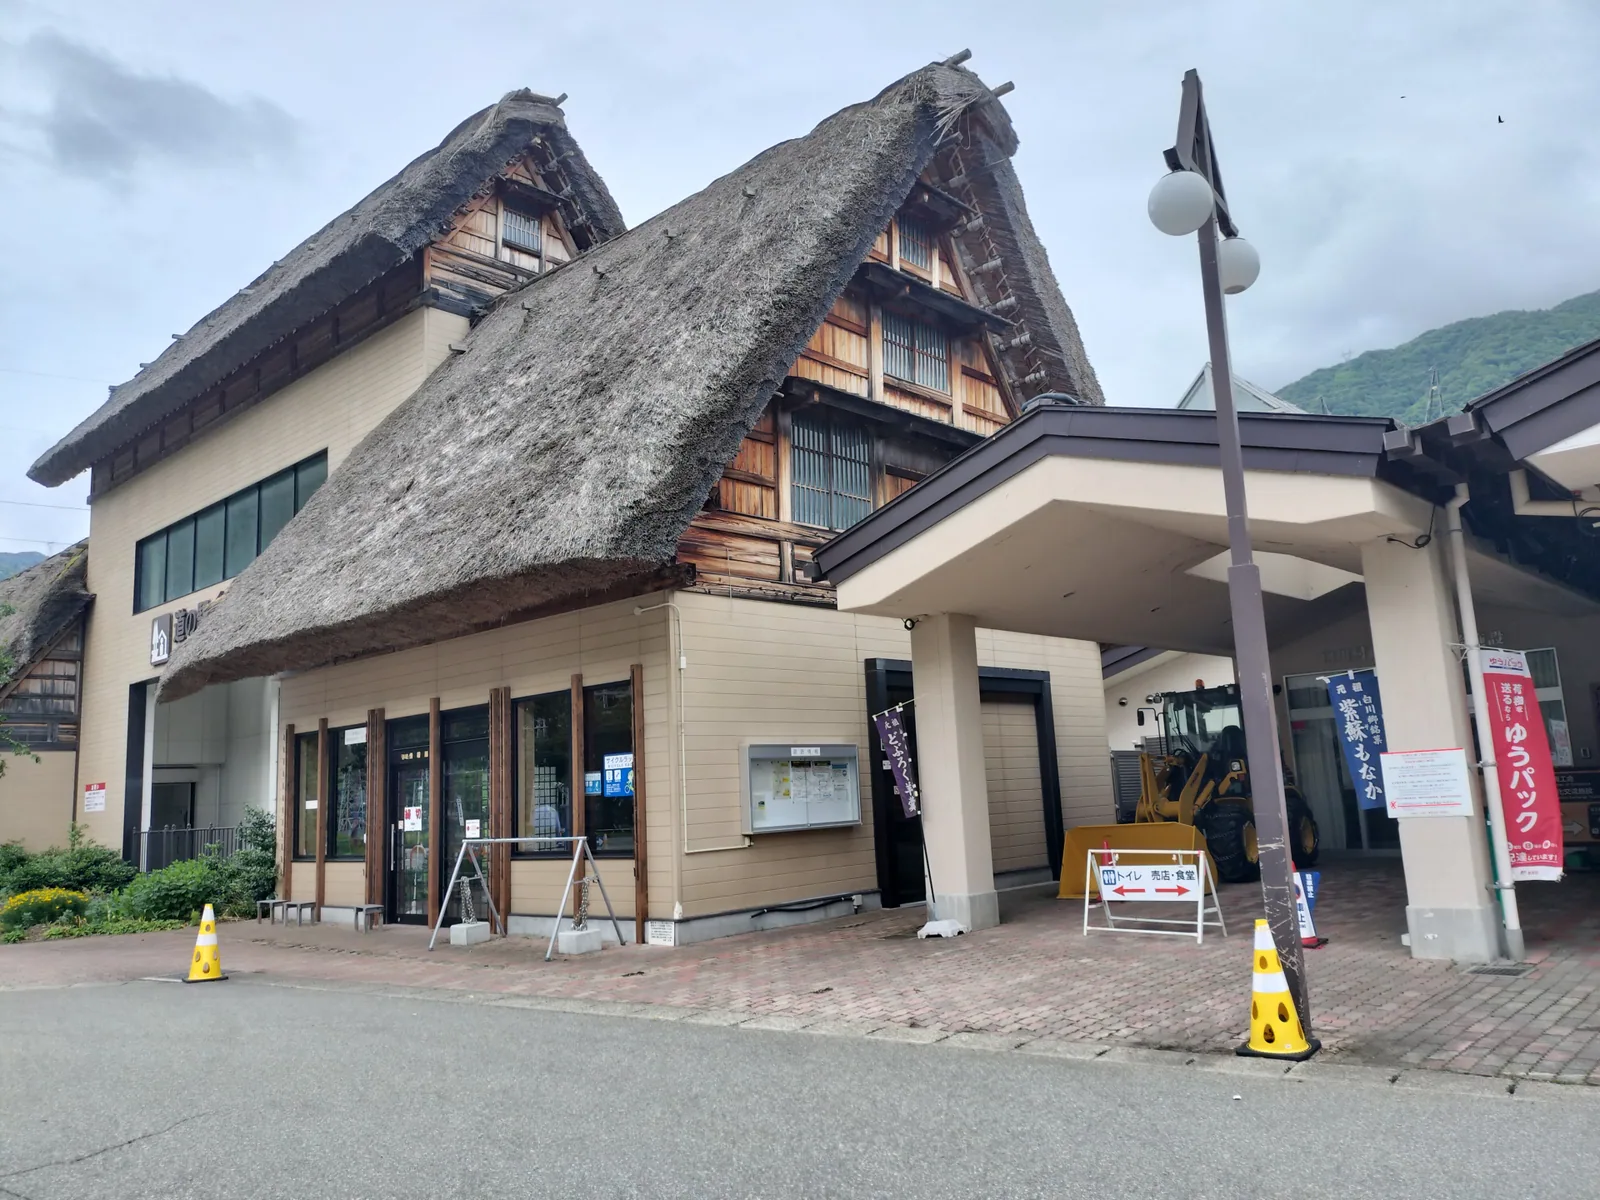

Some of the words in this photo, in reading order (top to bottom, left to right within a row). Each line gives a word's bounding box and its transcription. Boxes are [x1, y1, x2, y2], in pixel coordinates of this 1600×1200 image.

[1336, 682, 1363, 695] 元祖
[1338, 698, 1383, 801] 紫蘇もなか
[1505, 722, 1538, 833] ゆうパック
[1117, 871, 1142, 881] トイレ
[1151, 870, 1195, 881] 売店・食堂
